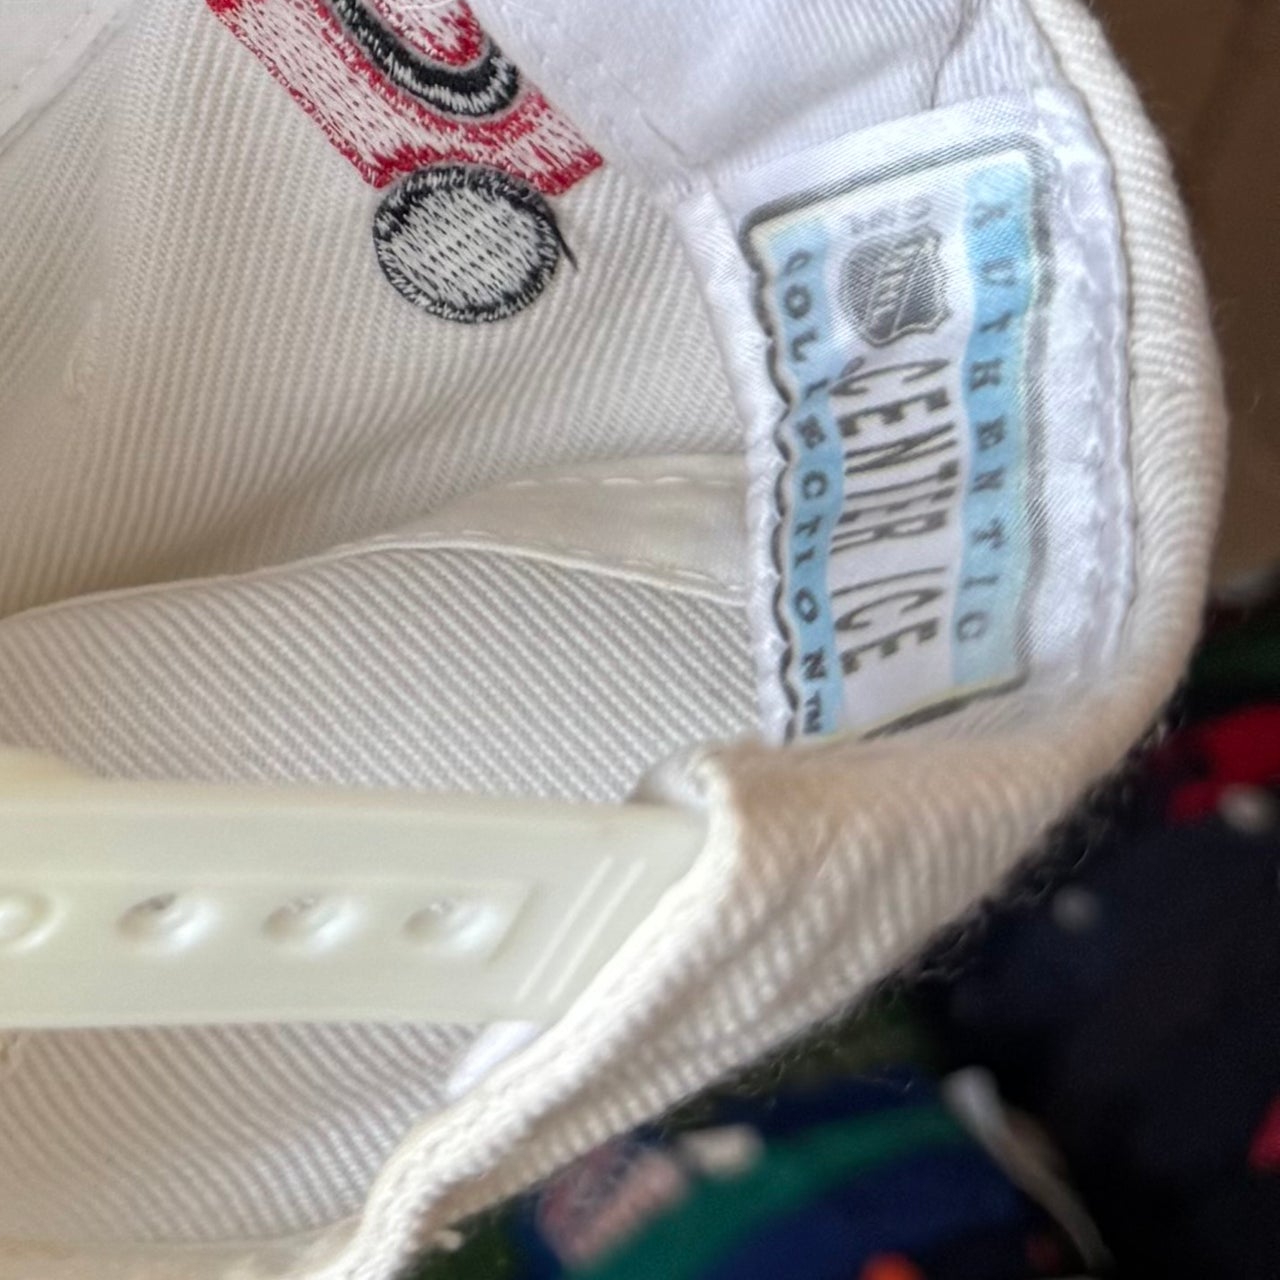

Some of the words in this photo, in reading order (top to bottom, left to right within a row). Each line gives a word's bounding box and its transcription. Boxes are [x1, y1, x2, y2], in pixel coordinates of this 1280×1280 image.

[830, 354, 962, 557] CENTER
[954, 198, 1020, 643] AUTHENTIC
[831, 564, 950, 676] ICE
